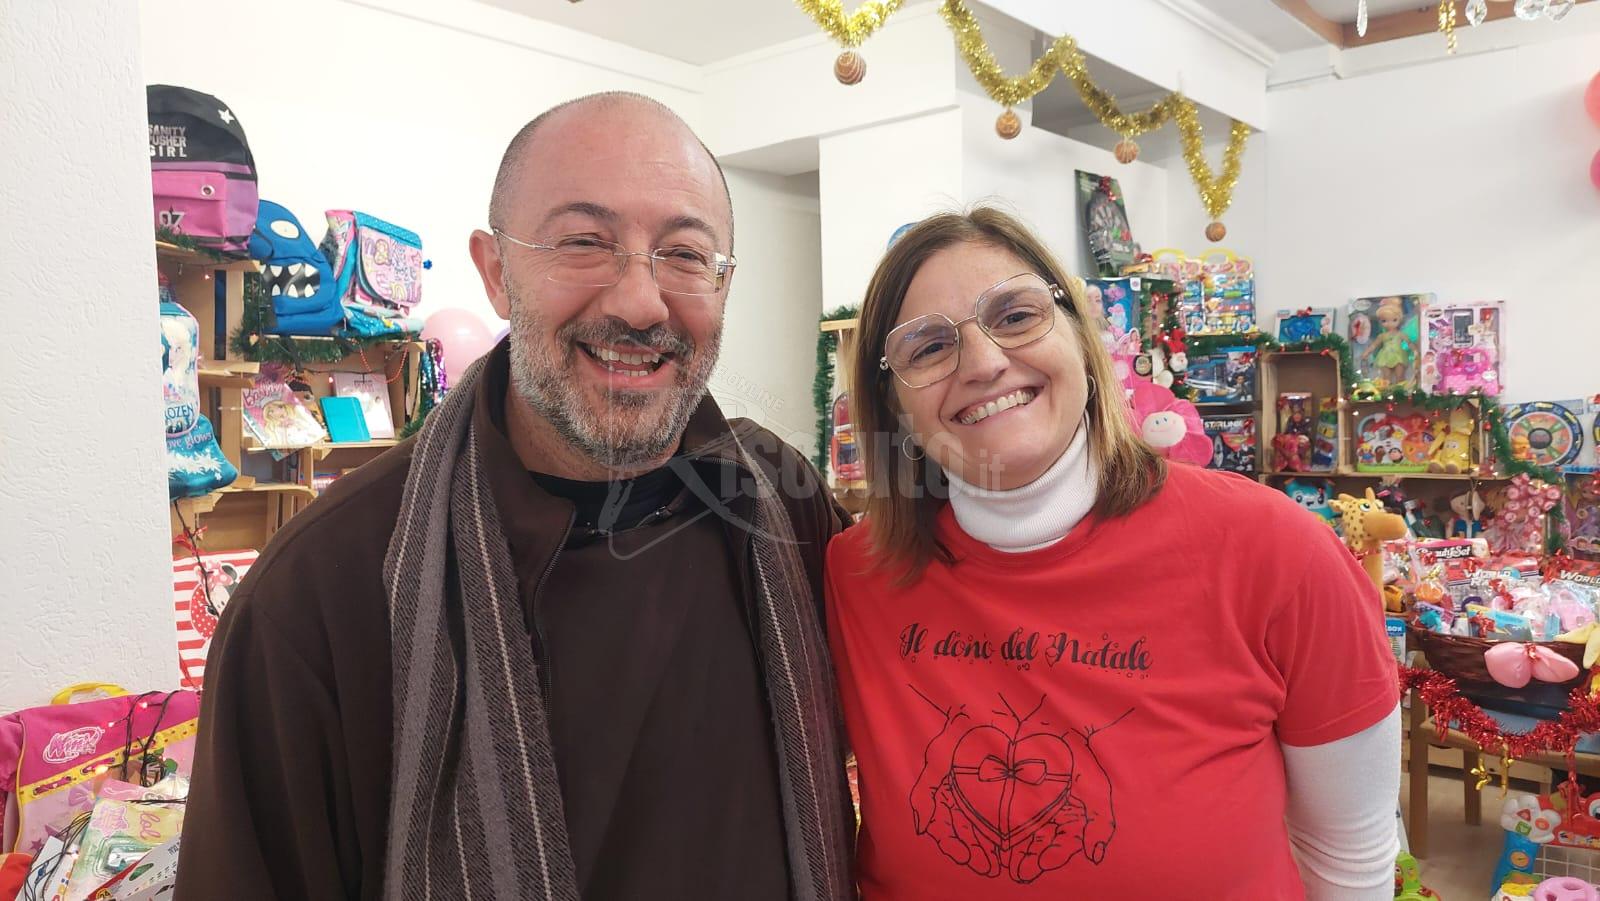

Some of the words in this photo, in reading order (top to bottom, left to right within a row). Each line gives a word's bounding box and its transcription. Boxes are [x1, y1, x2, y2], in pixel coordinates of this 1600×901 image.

[900, 623, 929, 658] Il
[933, 630, 996, 660] dono
[1000, 627, 1041, 662] del
[1047, 632, 1153, 671] Natale
